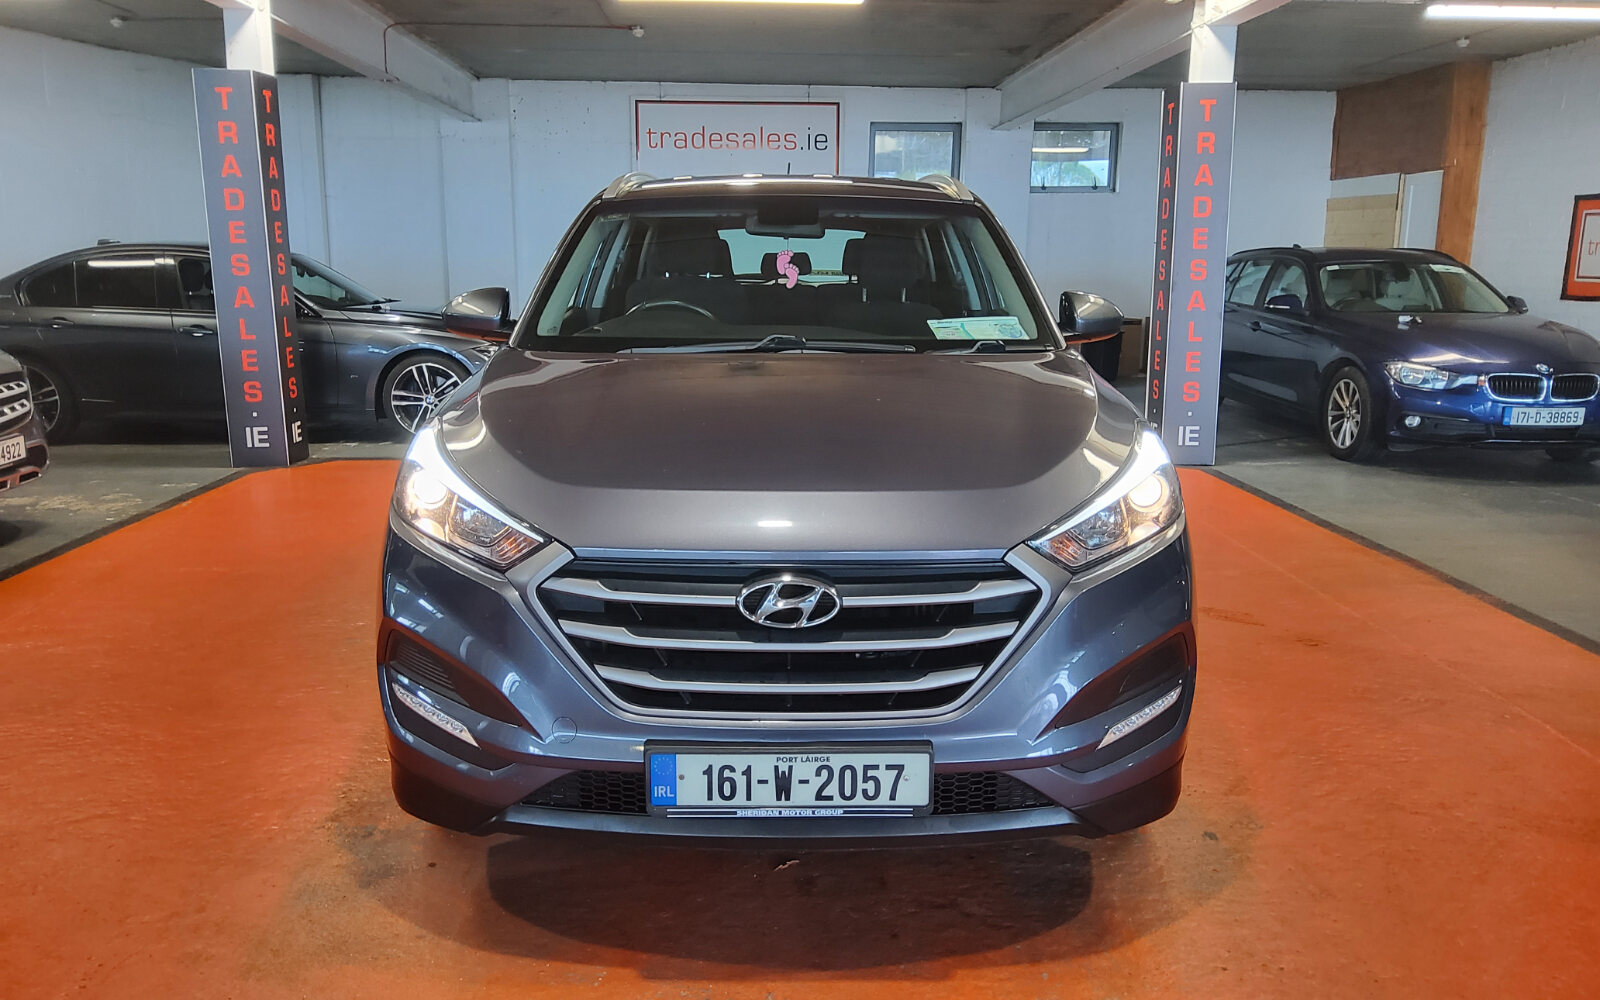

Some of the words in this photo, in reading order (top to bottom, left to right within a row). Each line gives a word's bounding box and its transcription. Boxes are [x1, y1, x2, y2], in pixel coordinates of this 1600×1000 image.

[646, 125, 828, 151] tradesales.ie
[1516, 411, 1579, 424] 171-D-38869
[800, 755, 831, 763] LÁIRGE
[701, 764, 906, 802] 161-W-2057
[653, 785, 675, 798] IRL
[736, 809, 779, 817] SHERIDAN
[781, 809, 813, 817] MOTOR
[814, 809, 844, 817] GROUP
